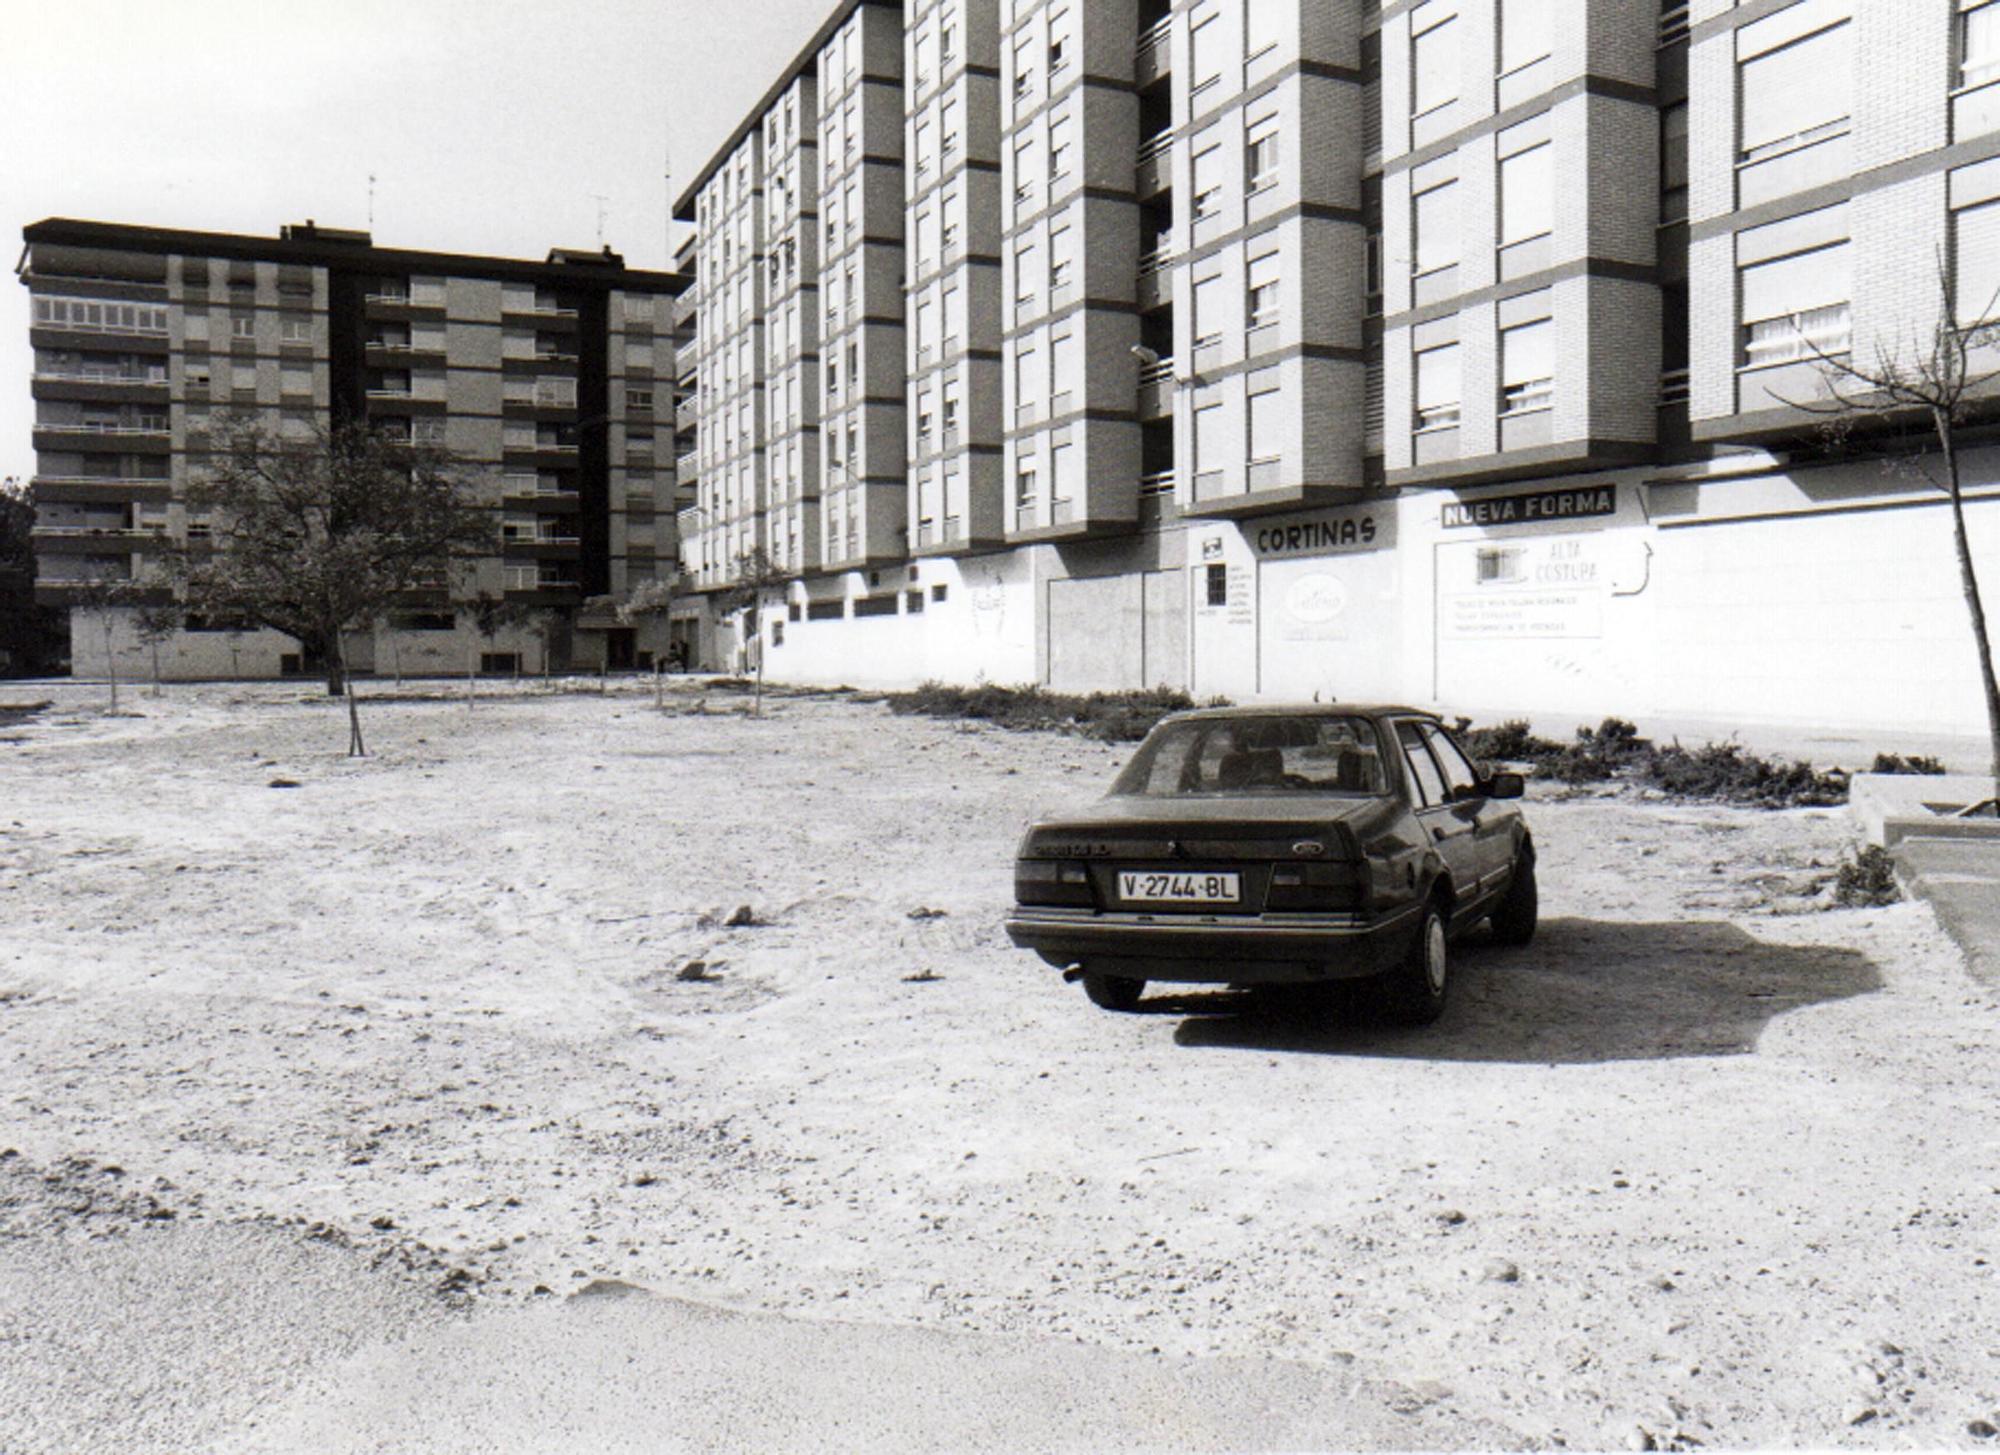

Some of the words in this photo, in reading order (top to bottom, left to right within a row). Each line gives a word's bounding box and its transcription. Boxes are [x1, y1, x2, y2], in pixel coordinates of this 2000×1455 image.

[1443, 499, 1517, 527] NUEVA
[1525, 487, 1614, 517] FORMA
[1257, 517, 1377, 553] CORTINAS
